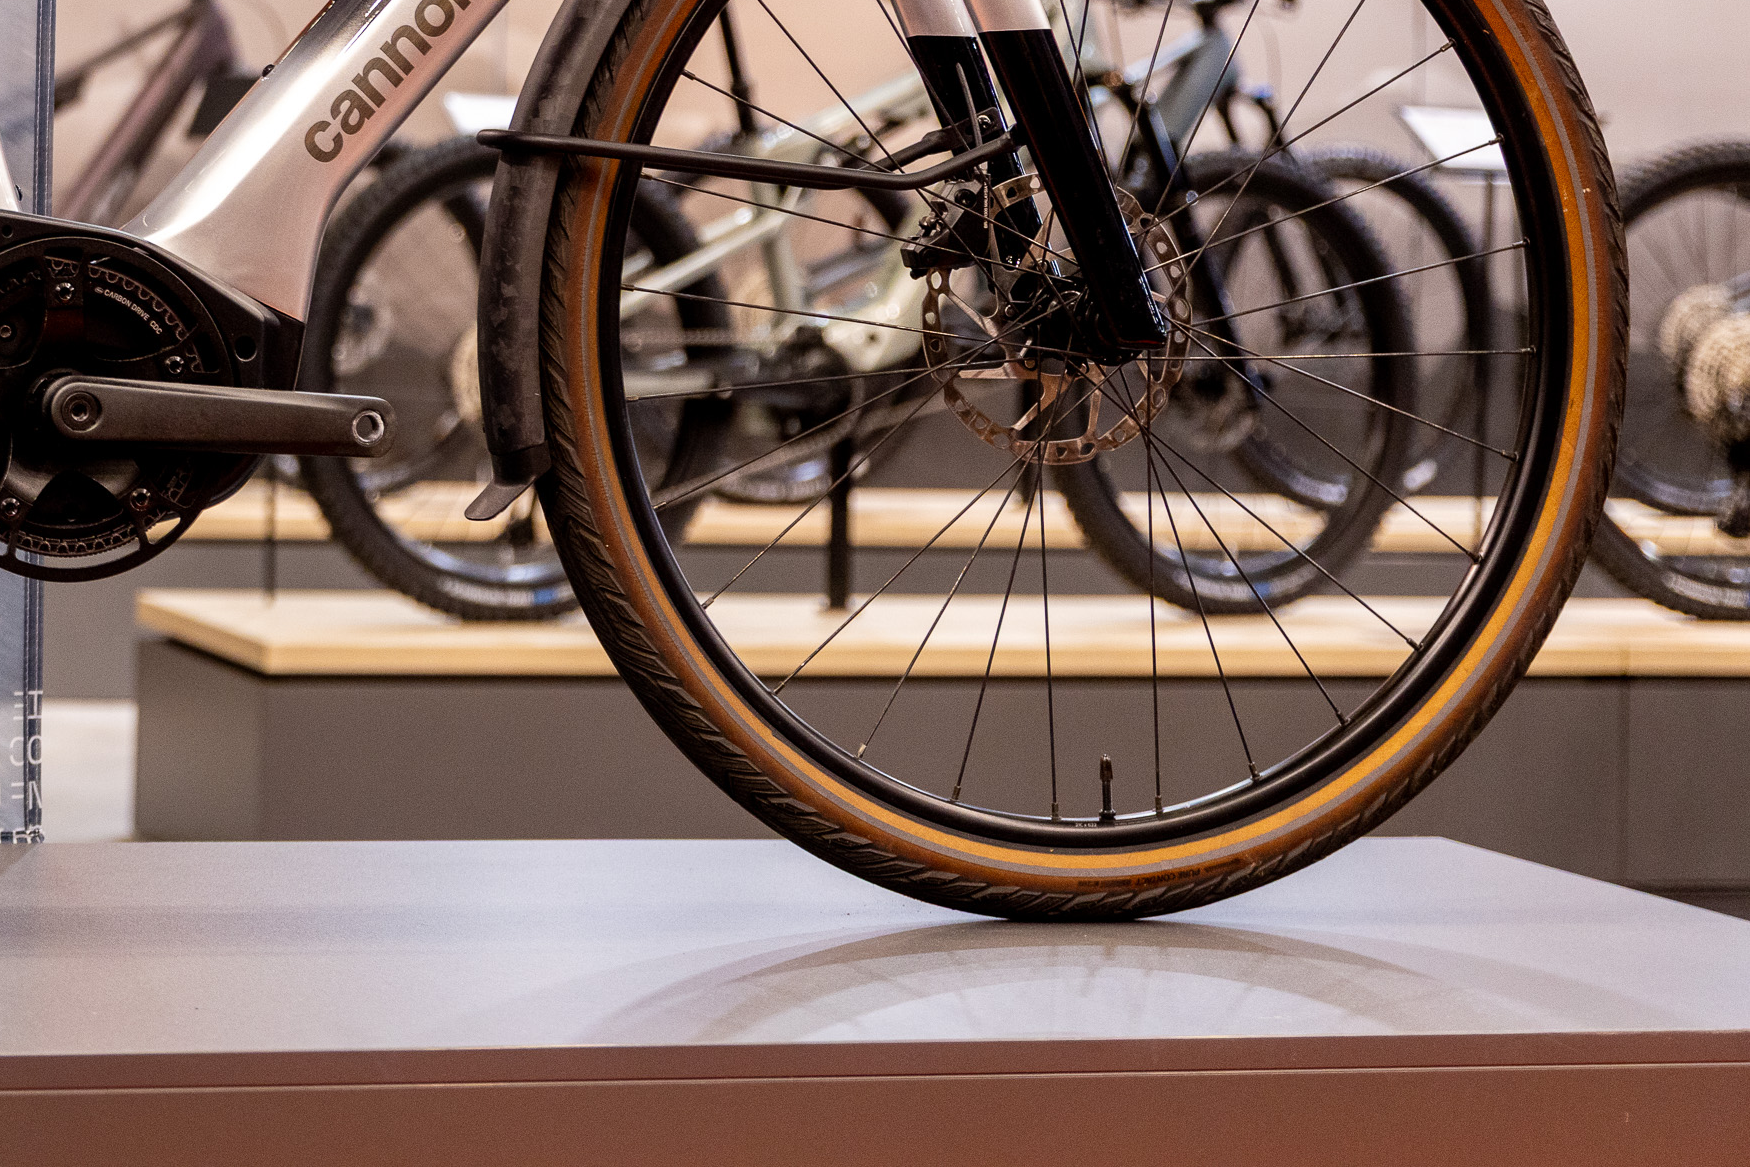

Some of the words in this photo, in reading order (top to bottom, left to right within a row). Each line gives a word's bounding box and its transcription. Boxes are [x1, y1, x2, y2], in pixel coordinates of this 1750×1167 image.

[104, 289, 132, 307] CARBON
[131, 303, 150, 321] DRIVE
[150, 320, 163, 334] CDC
[1135, 872, 1177, 887] CONTACT
[1179, 868, 1201, 879] PURE
